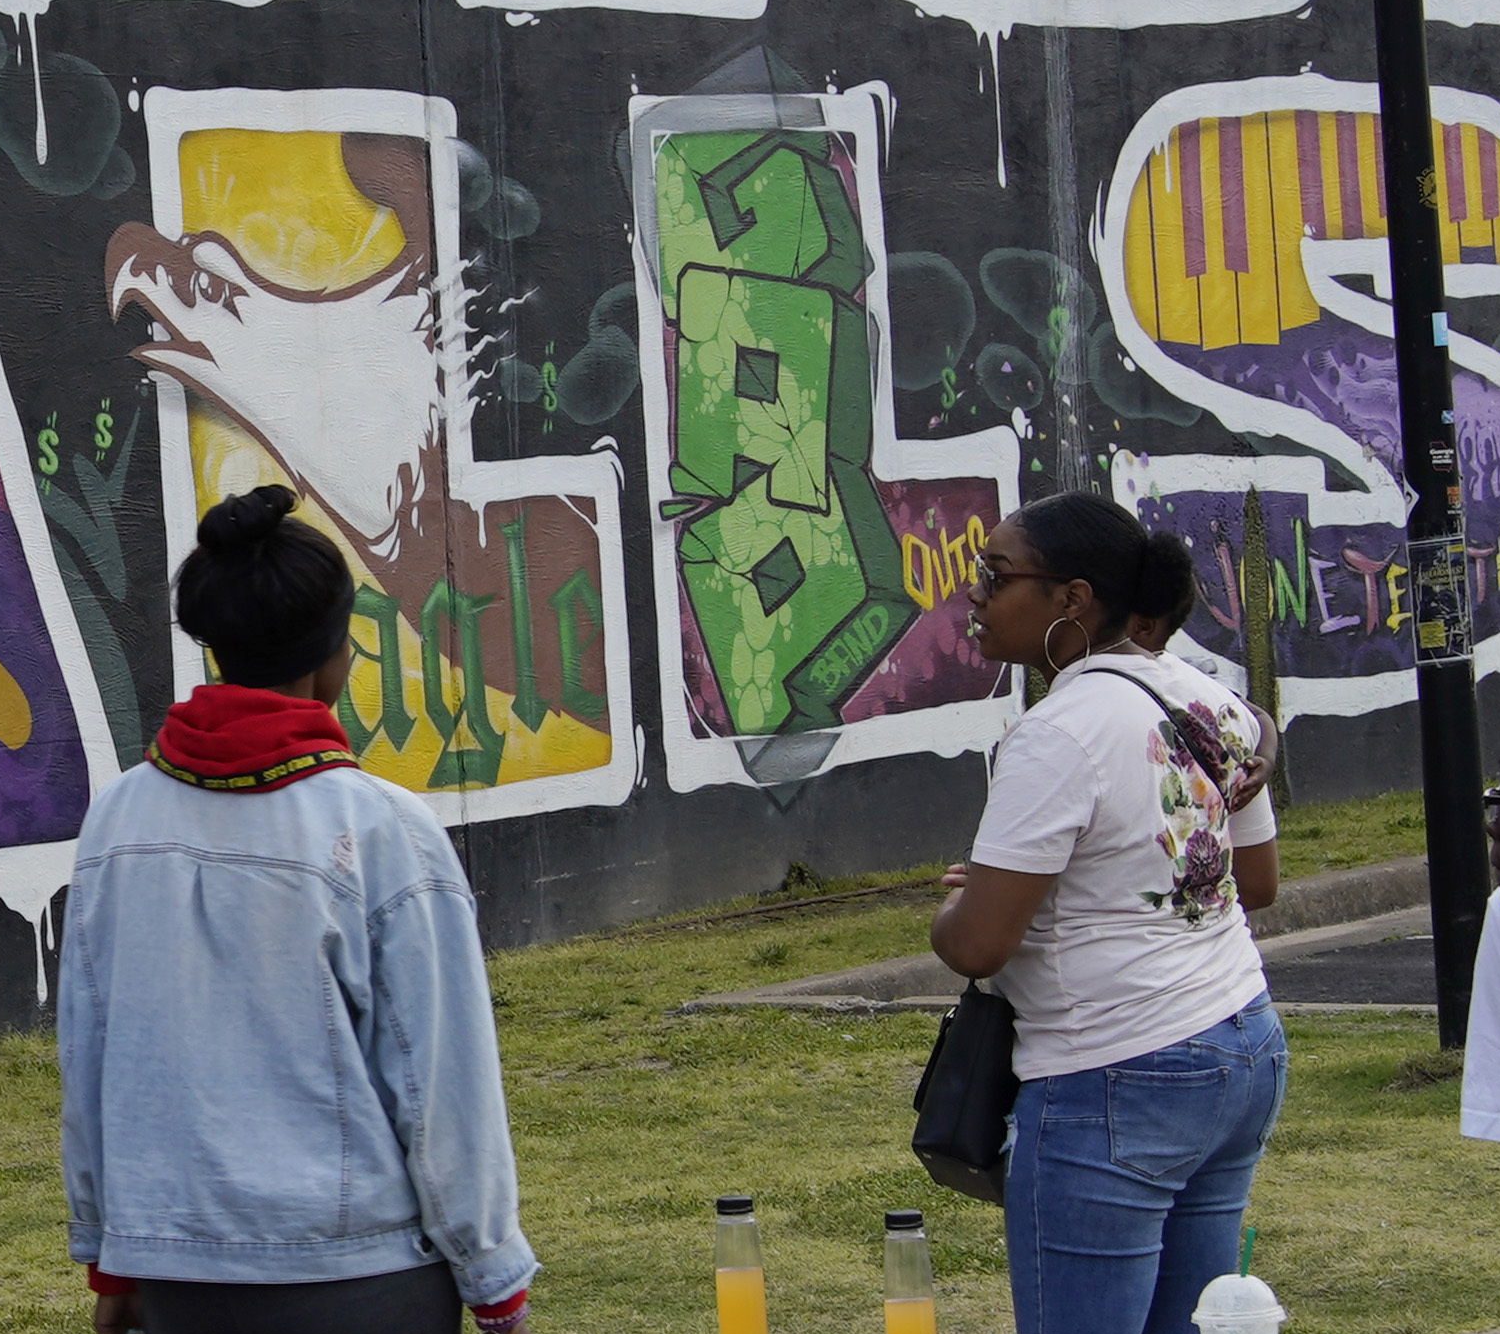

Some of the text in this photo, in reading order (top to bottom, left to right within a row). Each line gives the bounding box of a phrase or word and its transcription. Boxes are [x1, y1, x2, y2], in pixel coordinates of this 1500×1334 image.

[901, 514, 990, 612] OUTS
[320, 503, 608, 789] agle
[810, 604, 891, 698] BAND
